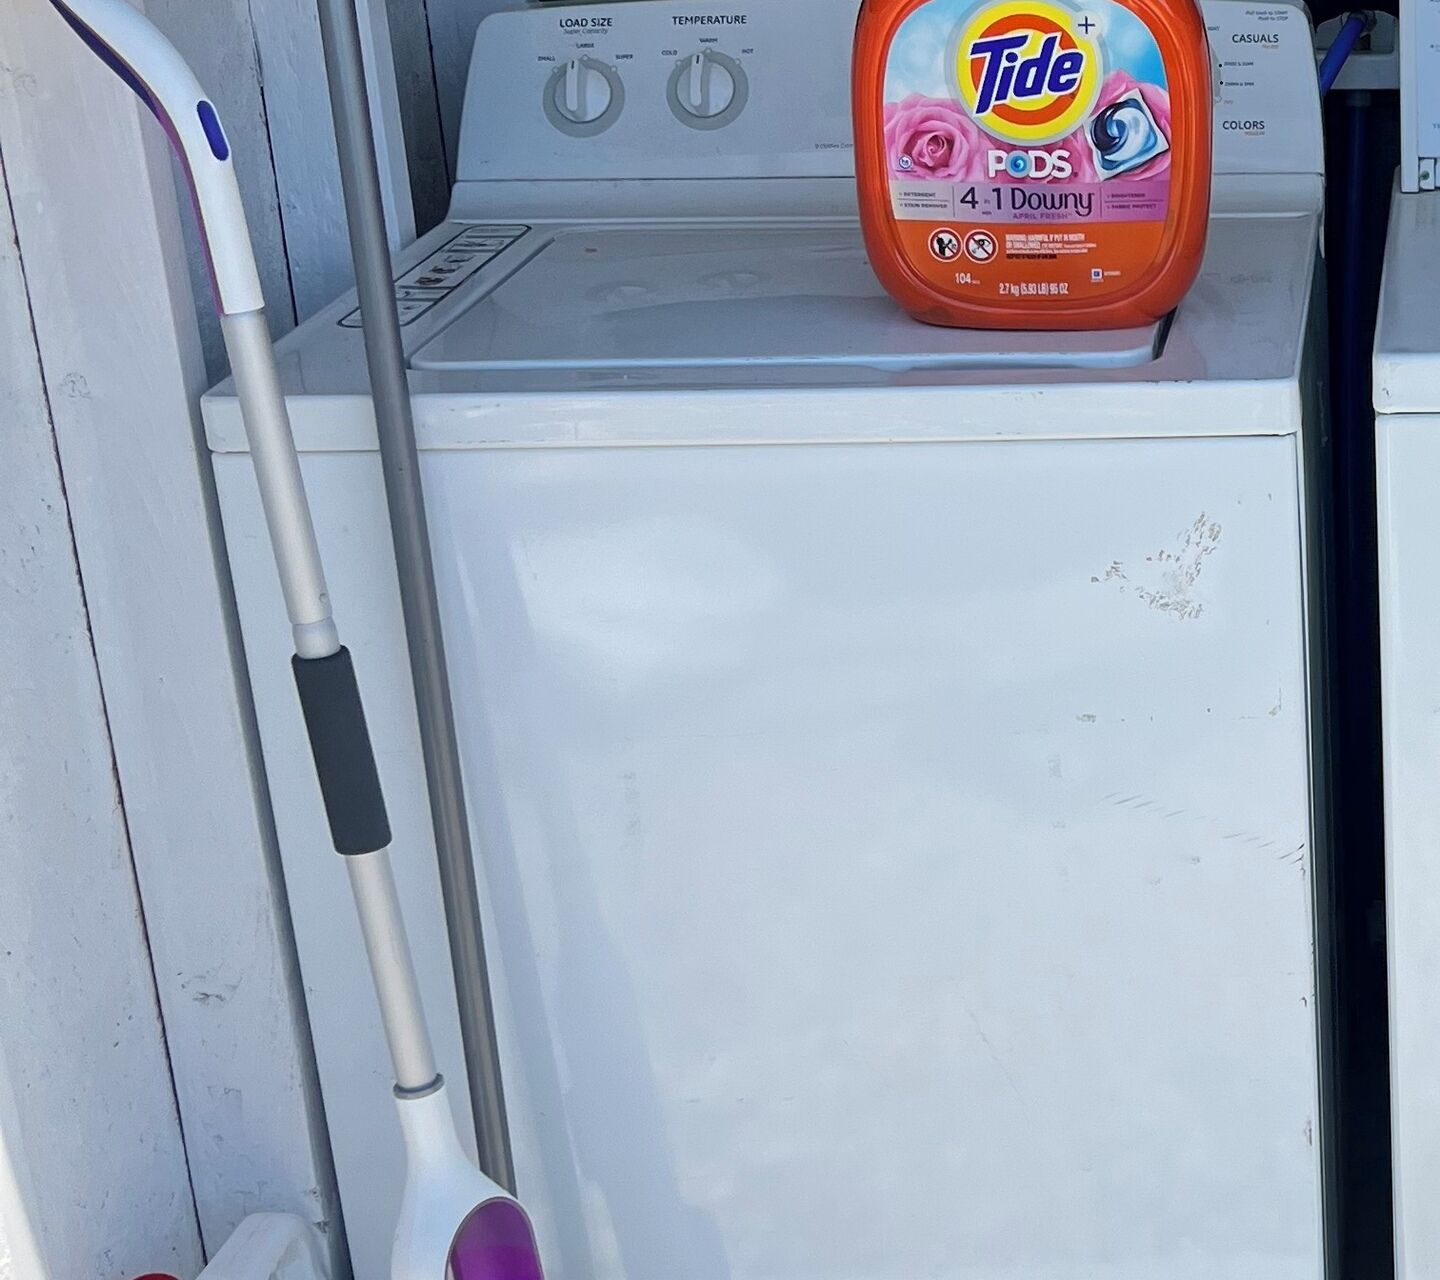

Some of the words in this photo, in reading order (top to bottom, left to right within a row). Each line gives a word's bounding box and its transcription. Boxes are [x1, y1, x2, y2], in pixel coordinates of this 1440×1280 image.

[559, 18, 588, 28] LOAD
[591, 17, 613, 27] SIZE
[672, 15, 748, 25] TEMPERATURE
[1232, 34, 1279, 44] CASUALS
[970, 33, 1084, 115] Tide
[1223, 121, 1265, 131] COLORS
[987, 149, 1072, 180] PODS
[960, 187, 978, 210] 4
[992, 187, 1002, 210] 1
[1011, 187, 1093, 218] Downy
[1012, 212, 1037, 220] APRIL
[1040, 212, 1068, 220] FRESH
[955, 273, 972, 285] 104
[999, 283, 1009, 295] 2.7
[1010, 283, 1020, 296] kg
[1059, 283, 1069, 295] OZ
